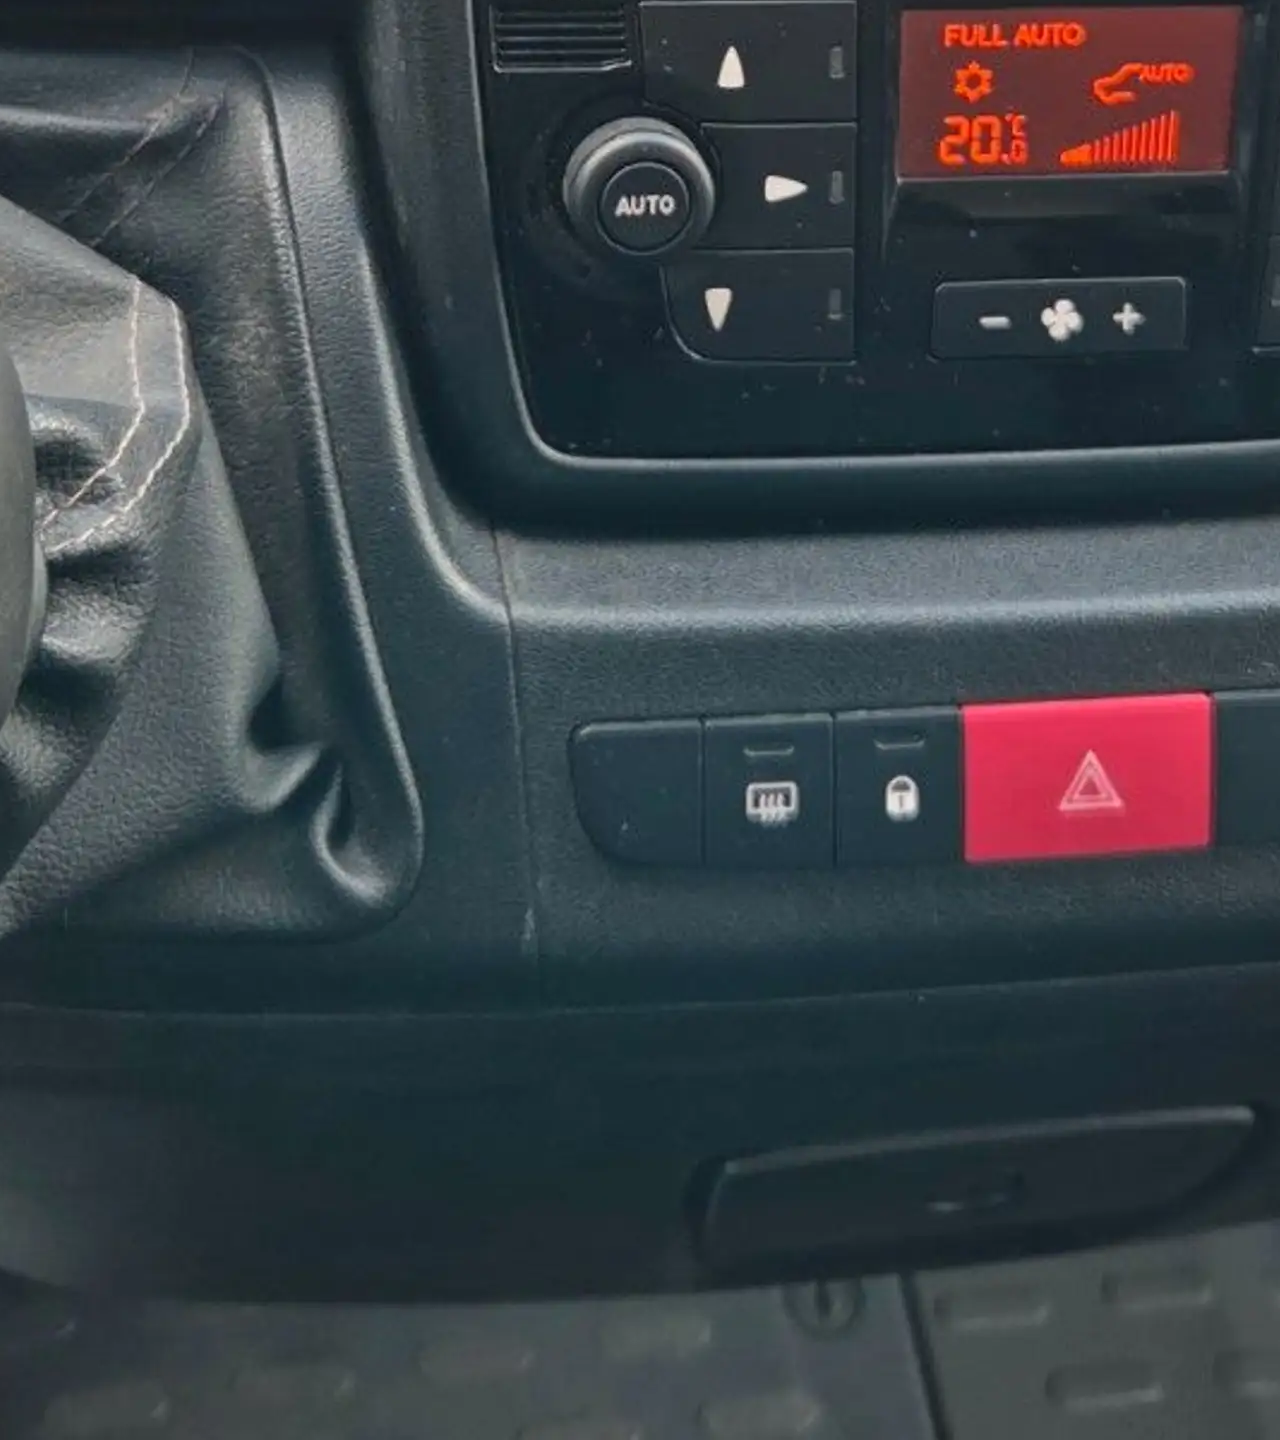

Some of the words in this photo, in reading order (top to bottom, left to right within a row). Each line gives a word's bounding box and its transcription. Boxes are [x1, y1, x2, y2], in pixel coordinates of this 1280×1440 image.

[944, 23, 1009, 47] FULL
[1013, 22, 1087, 47] AUTO
[1139, 63, 1194, 84] AUTO
[614, 193, 676, 217] AUTO
